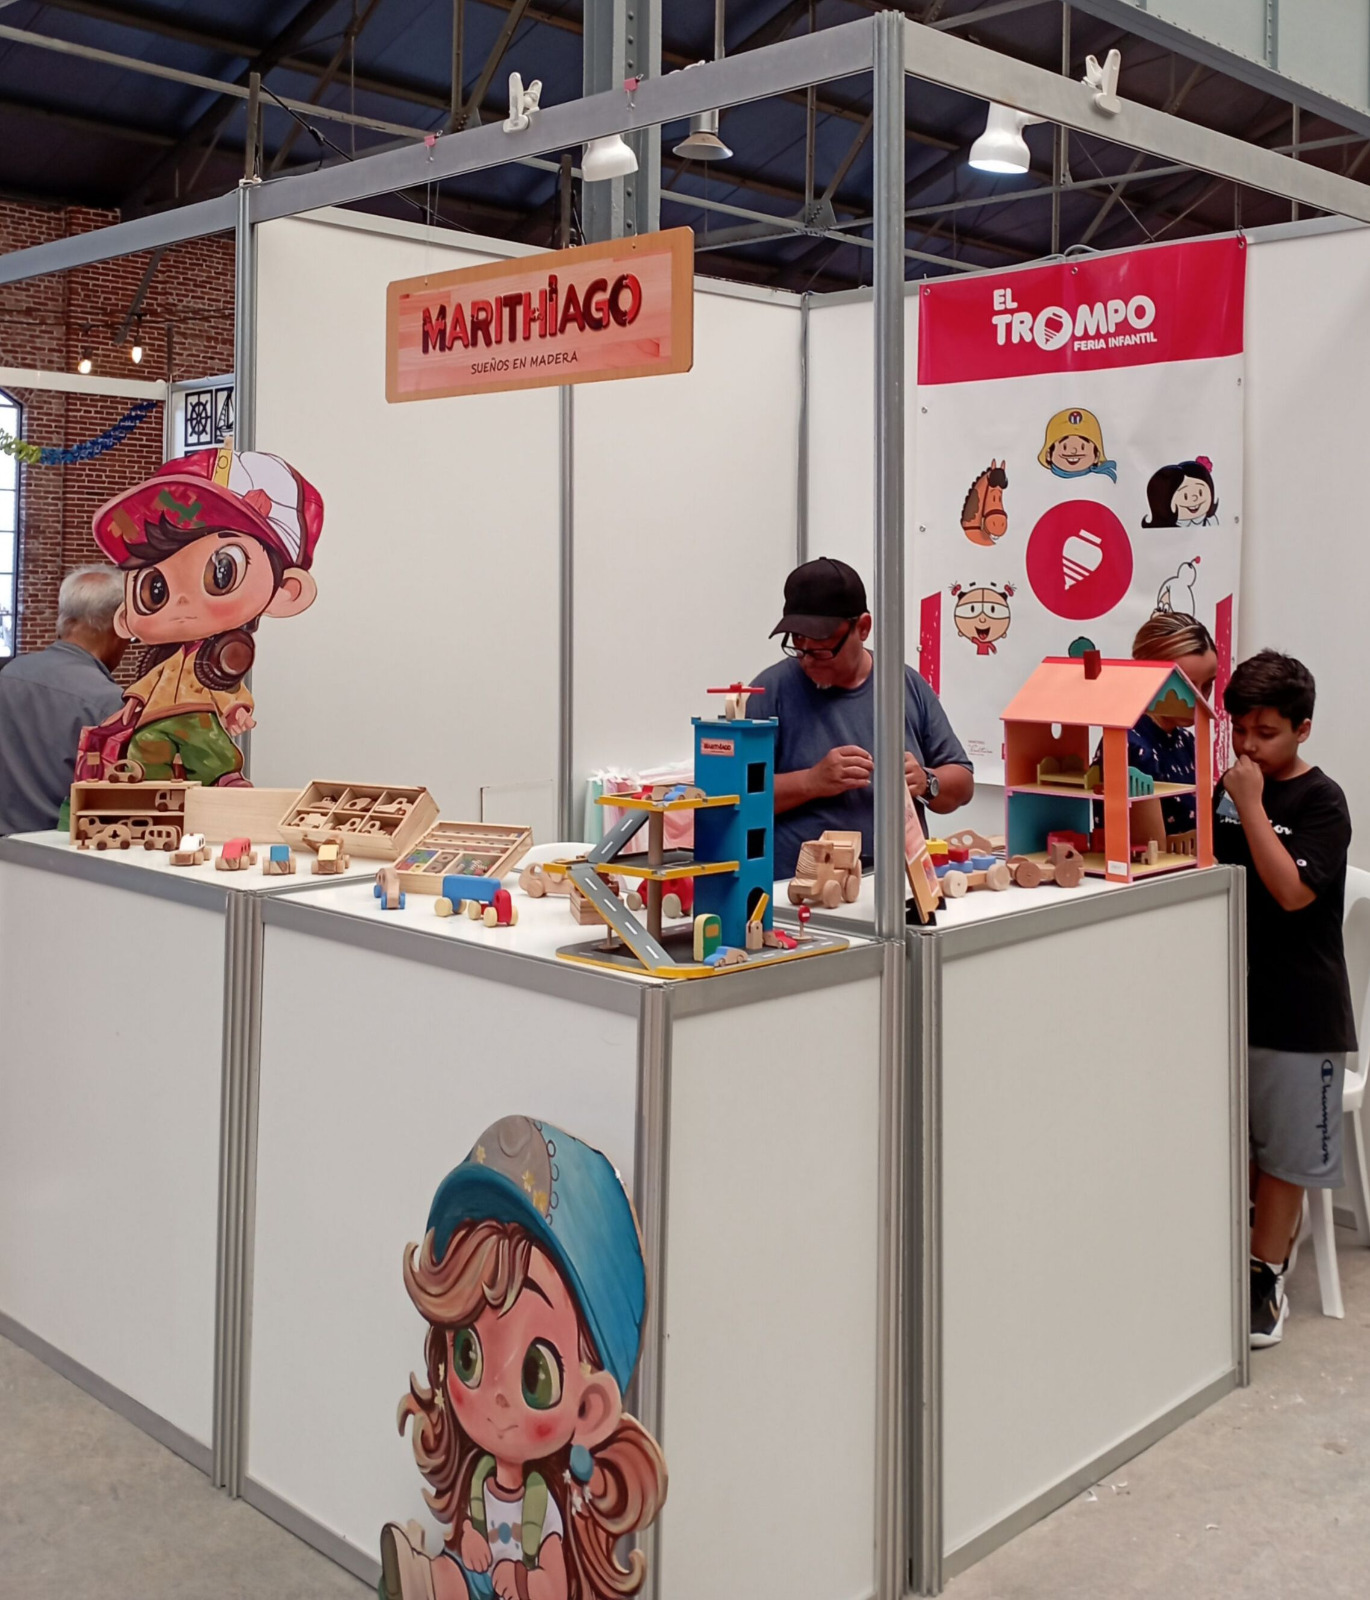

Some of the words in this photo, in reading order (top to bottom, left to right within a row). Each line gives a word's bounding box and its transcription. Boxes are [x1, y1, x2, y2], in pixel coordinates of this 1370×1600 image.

[993, 288, 1018, 311] EL
[992, 294, 1156, 351] TROMPO
[1074, 339, 1106, 351] FERIA
[1108, 332, 1157, 347] INFANTIL
[471, 357, 509, 375] SUEÑOS
[512, 358, 527, 370] EN
[530, 351, 578, 367] MADERA
[1315, 1059, 1334, 1166] Champion
